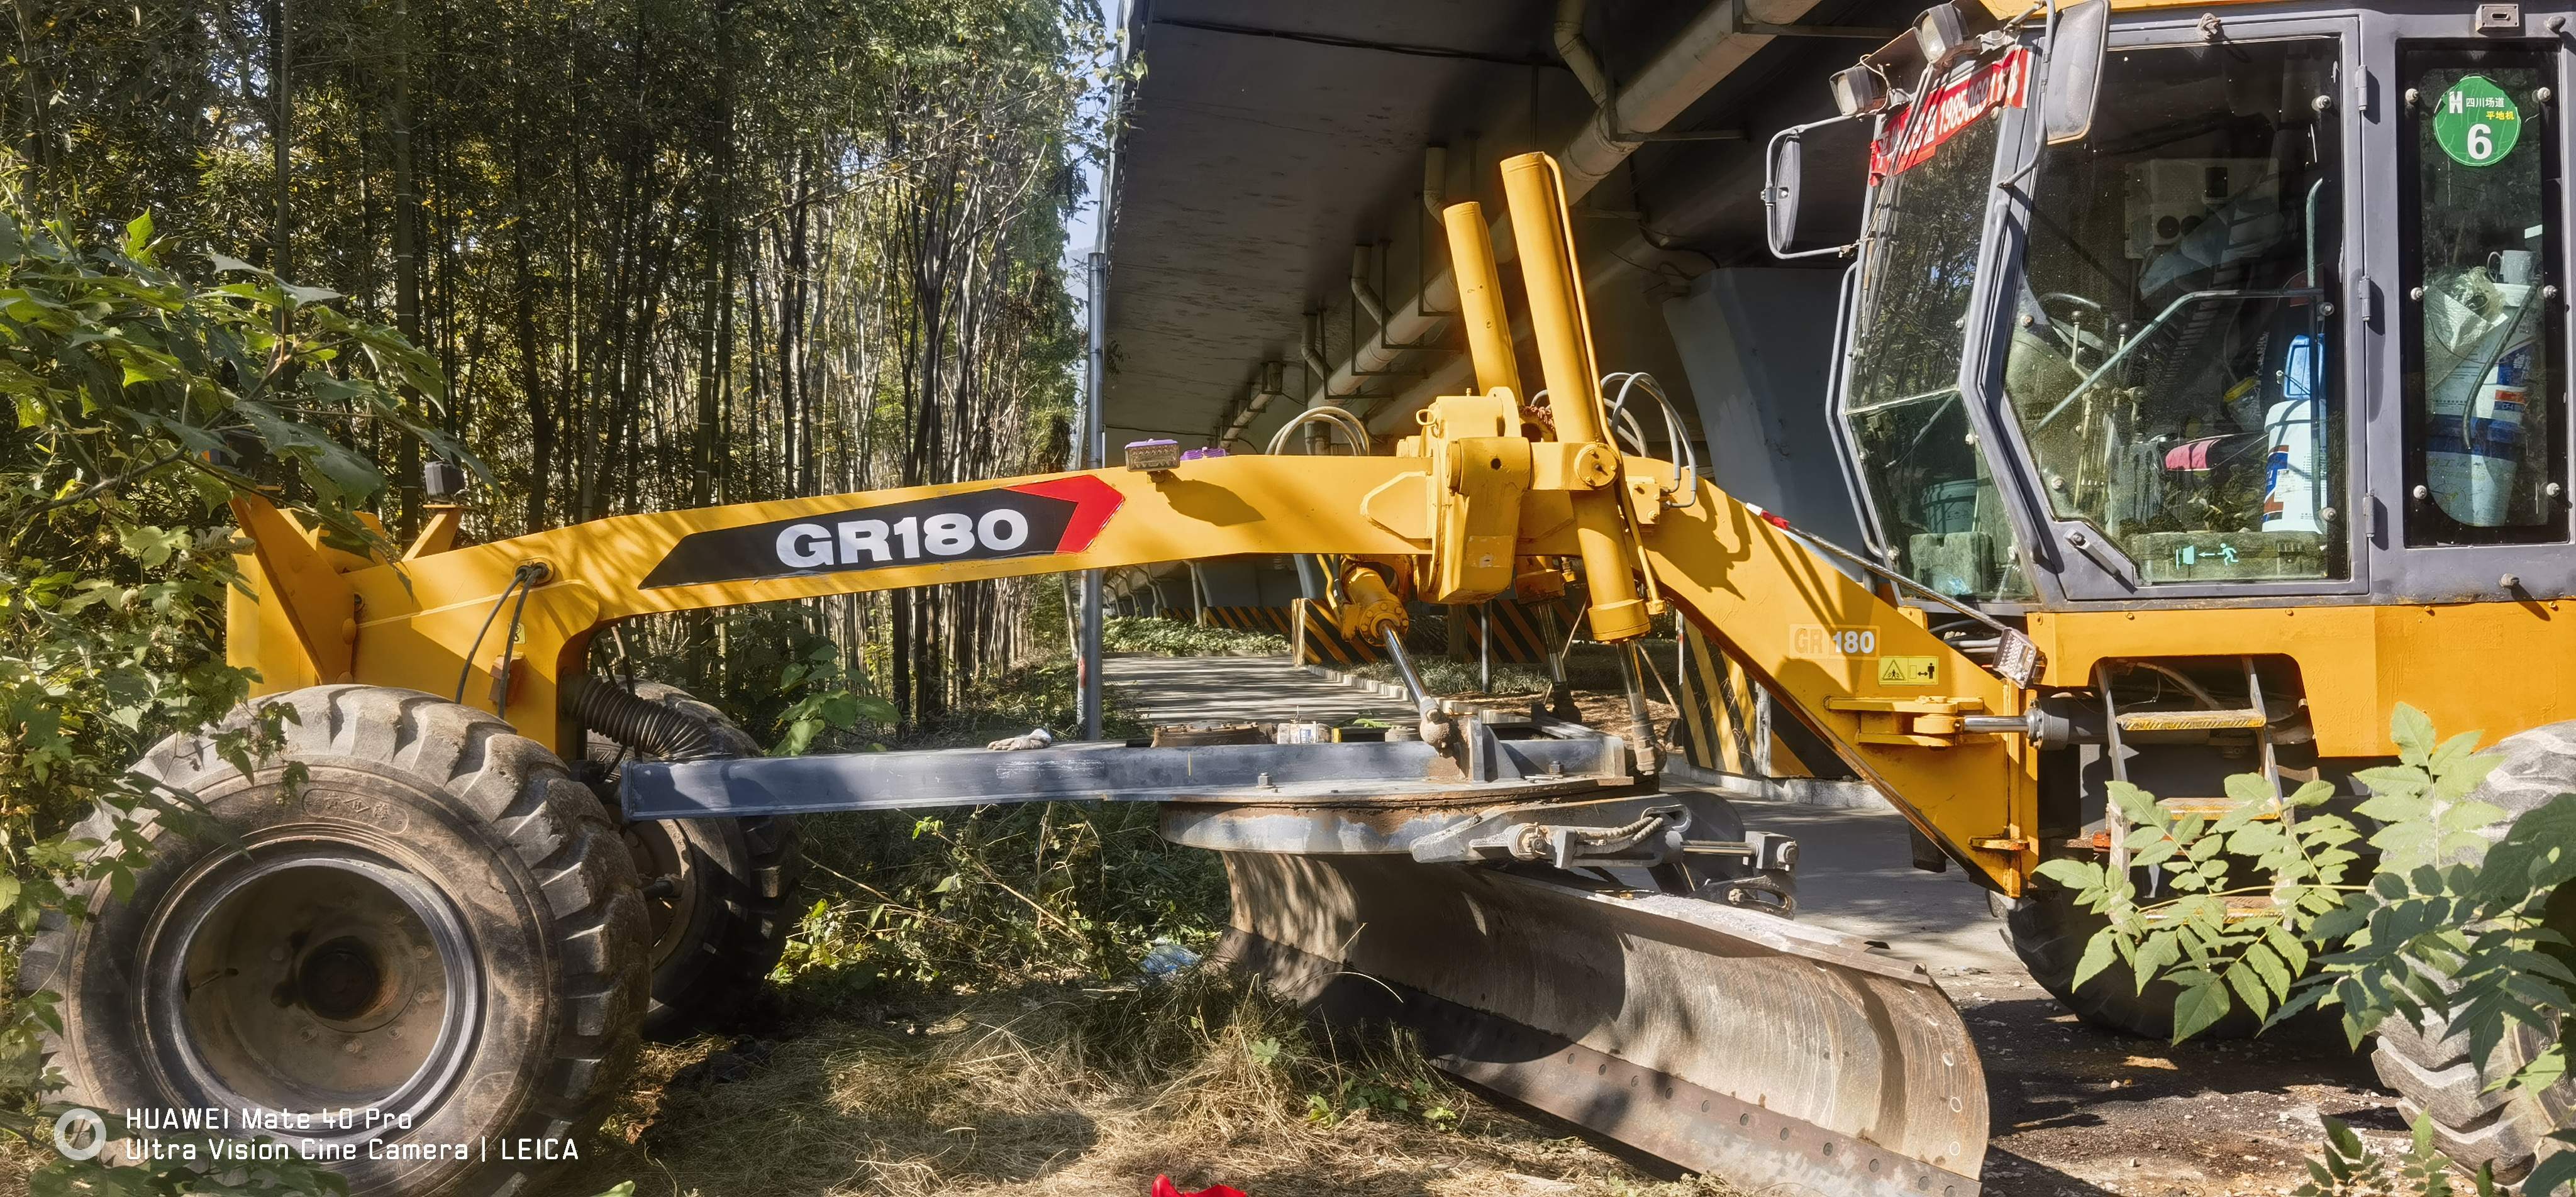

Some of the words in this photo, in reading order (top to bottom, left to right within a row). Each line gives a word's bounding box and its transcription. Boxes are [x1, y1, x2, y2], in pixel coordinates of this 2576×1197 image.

[2466, 97, 2504, 108] 四川场道
[2486, 111, 2514, 120] 平地机
[2468, 124, 2492, 160] 6
[775, 508, 1030, 568] GR180
